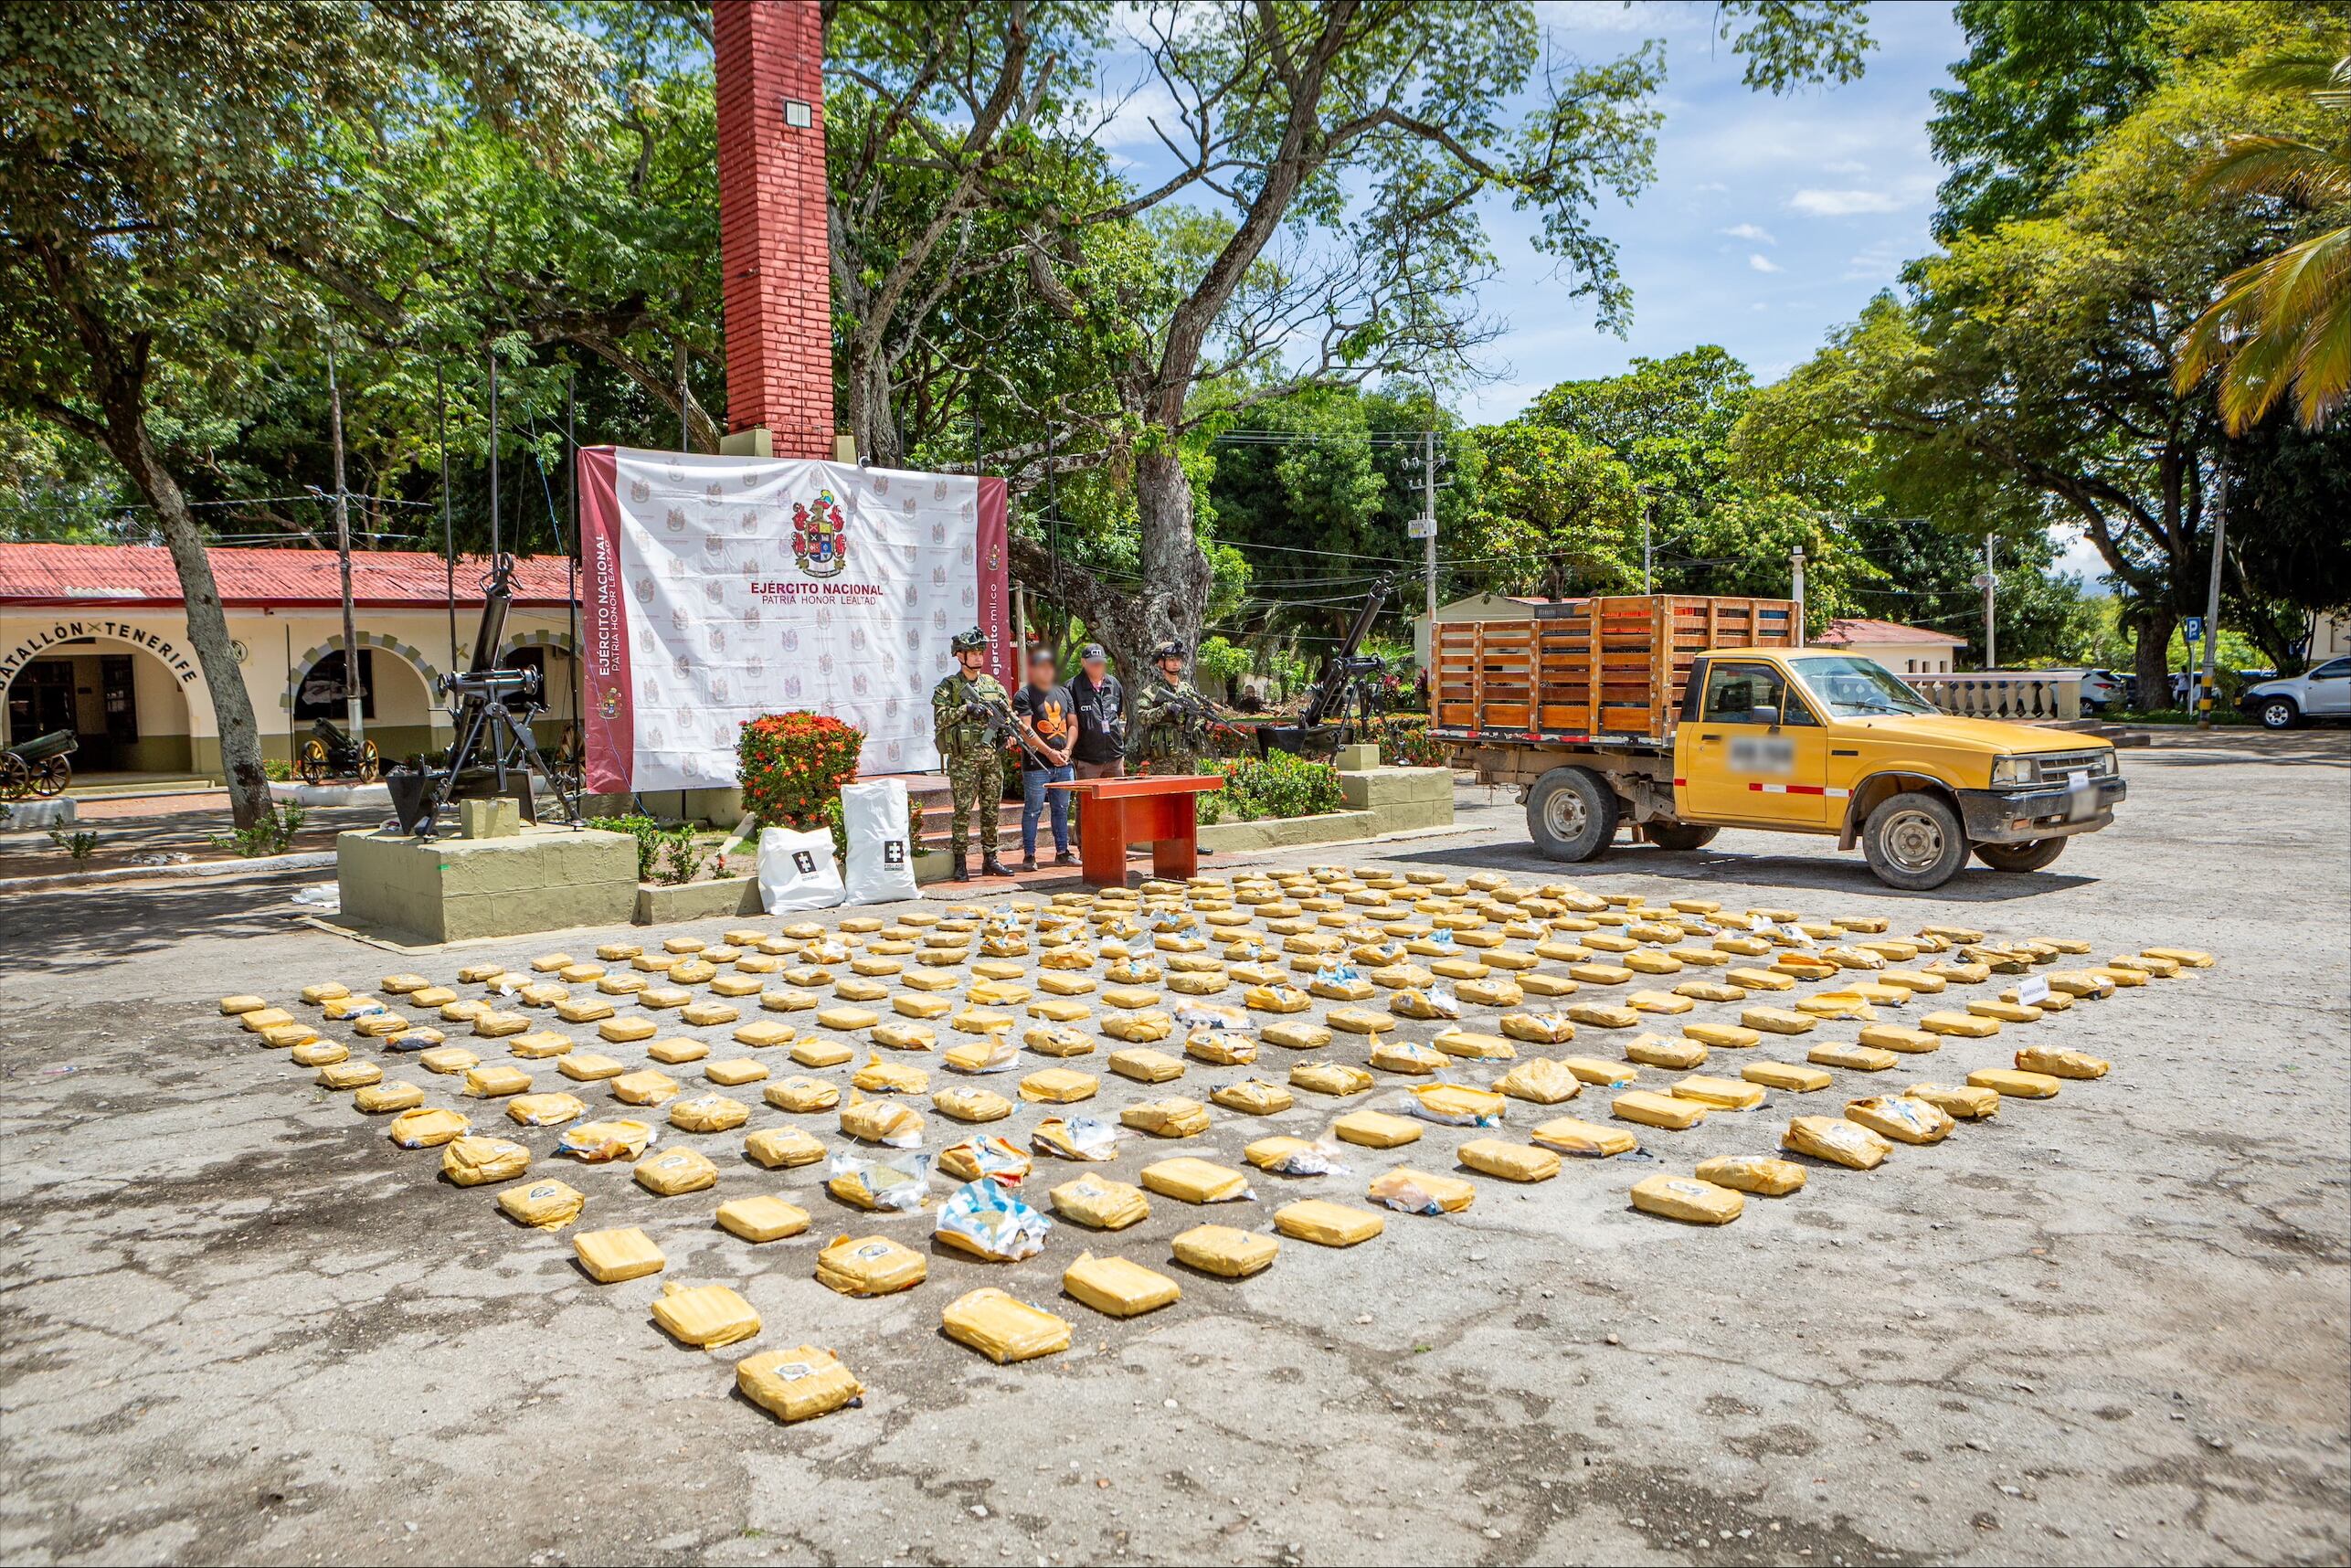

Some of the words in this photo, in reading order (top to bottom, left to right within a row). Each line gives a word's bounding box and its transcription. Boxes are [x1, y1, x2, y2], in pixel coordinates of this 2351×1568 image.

[596, 533, 609, 604] NACIONAL
[605, 540, 616, 588] LEALTAD
[751, 580, 819, 594] EJÉRCITO
[823, 583, 884, 596] NACIONAL
[762, 595, 796, 605] PATRIA
[801, 596, 835, 605] HONOR
[842, 596, 876, 606] LEALTAD
[609, 590, 619, 630] HONOR
[2189, 620, 2197, 638] P
[105, 621, 197, 683] TENERIFE
[597, 608, 609, 676] EJÉRCITO
[611, 633, 620, 672] PATRIA
